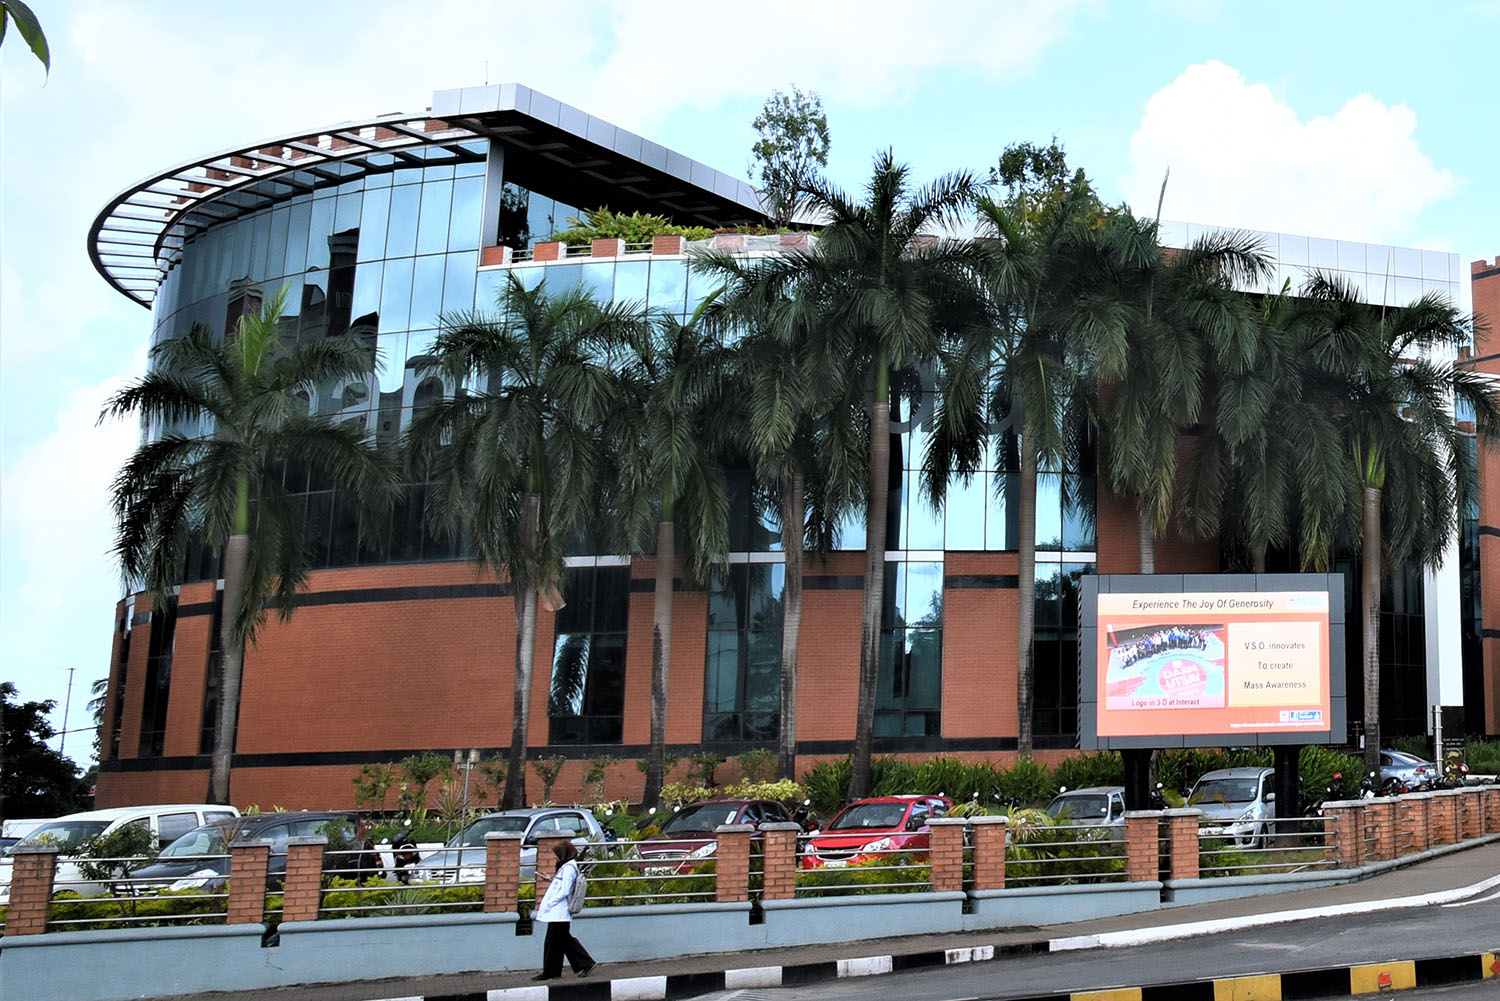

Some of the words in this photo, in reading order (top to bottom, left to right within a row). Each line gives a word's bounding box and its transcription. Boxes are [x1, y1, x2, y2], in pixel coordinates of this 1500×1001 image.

[1132, 600, 1179, 610] Experience
[1182, 600, 1197, 609] The
[1199, 600, 1214, 610] Joy
[1216, 599, 1227, 608] Of
[1228, 599, 1274, 610] Generosity
[1269, 642, 1305, 650] innovates
[1257, 661, 1268, 670] To
[1269, 662, 1294, 670] create
[1243, 681, 1264, 690] Mass
[1265, 681, 1307, 689] Awareness
[1131, 699, 1148, 708] Logo
[1176, 698, 1200, 706] Interact
